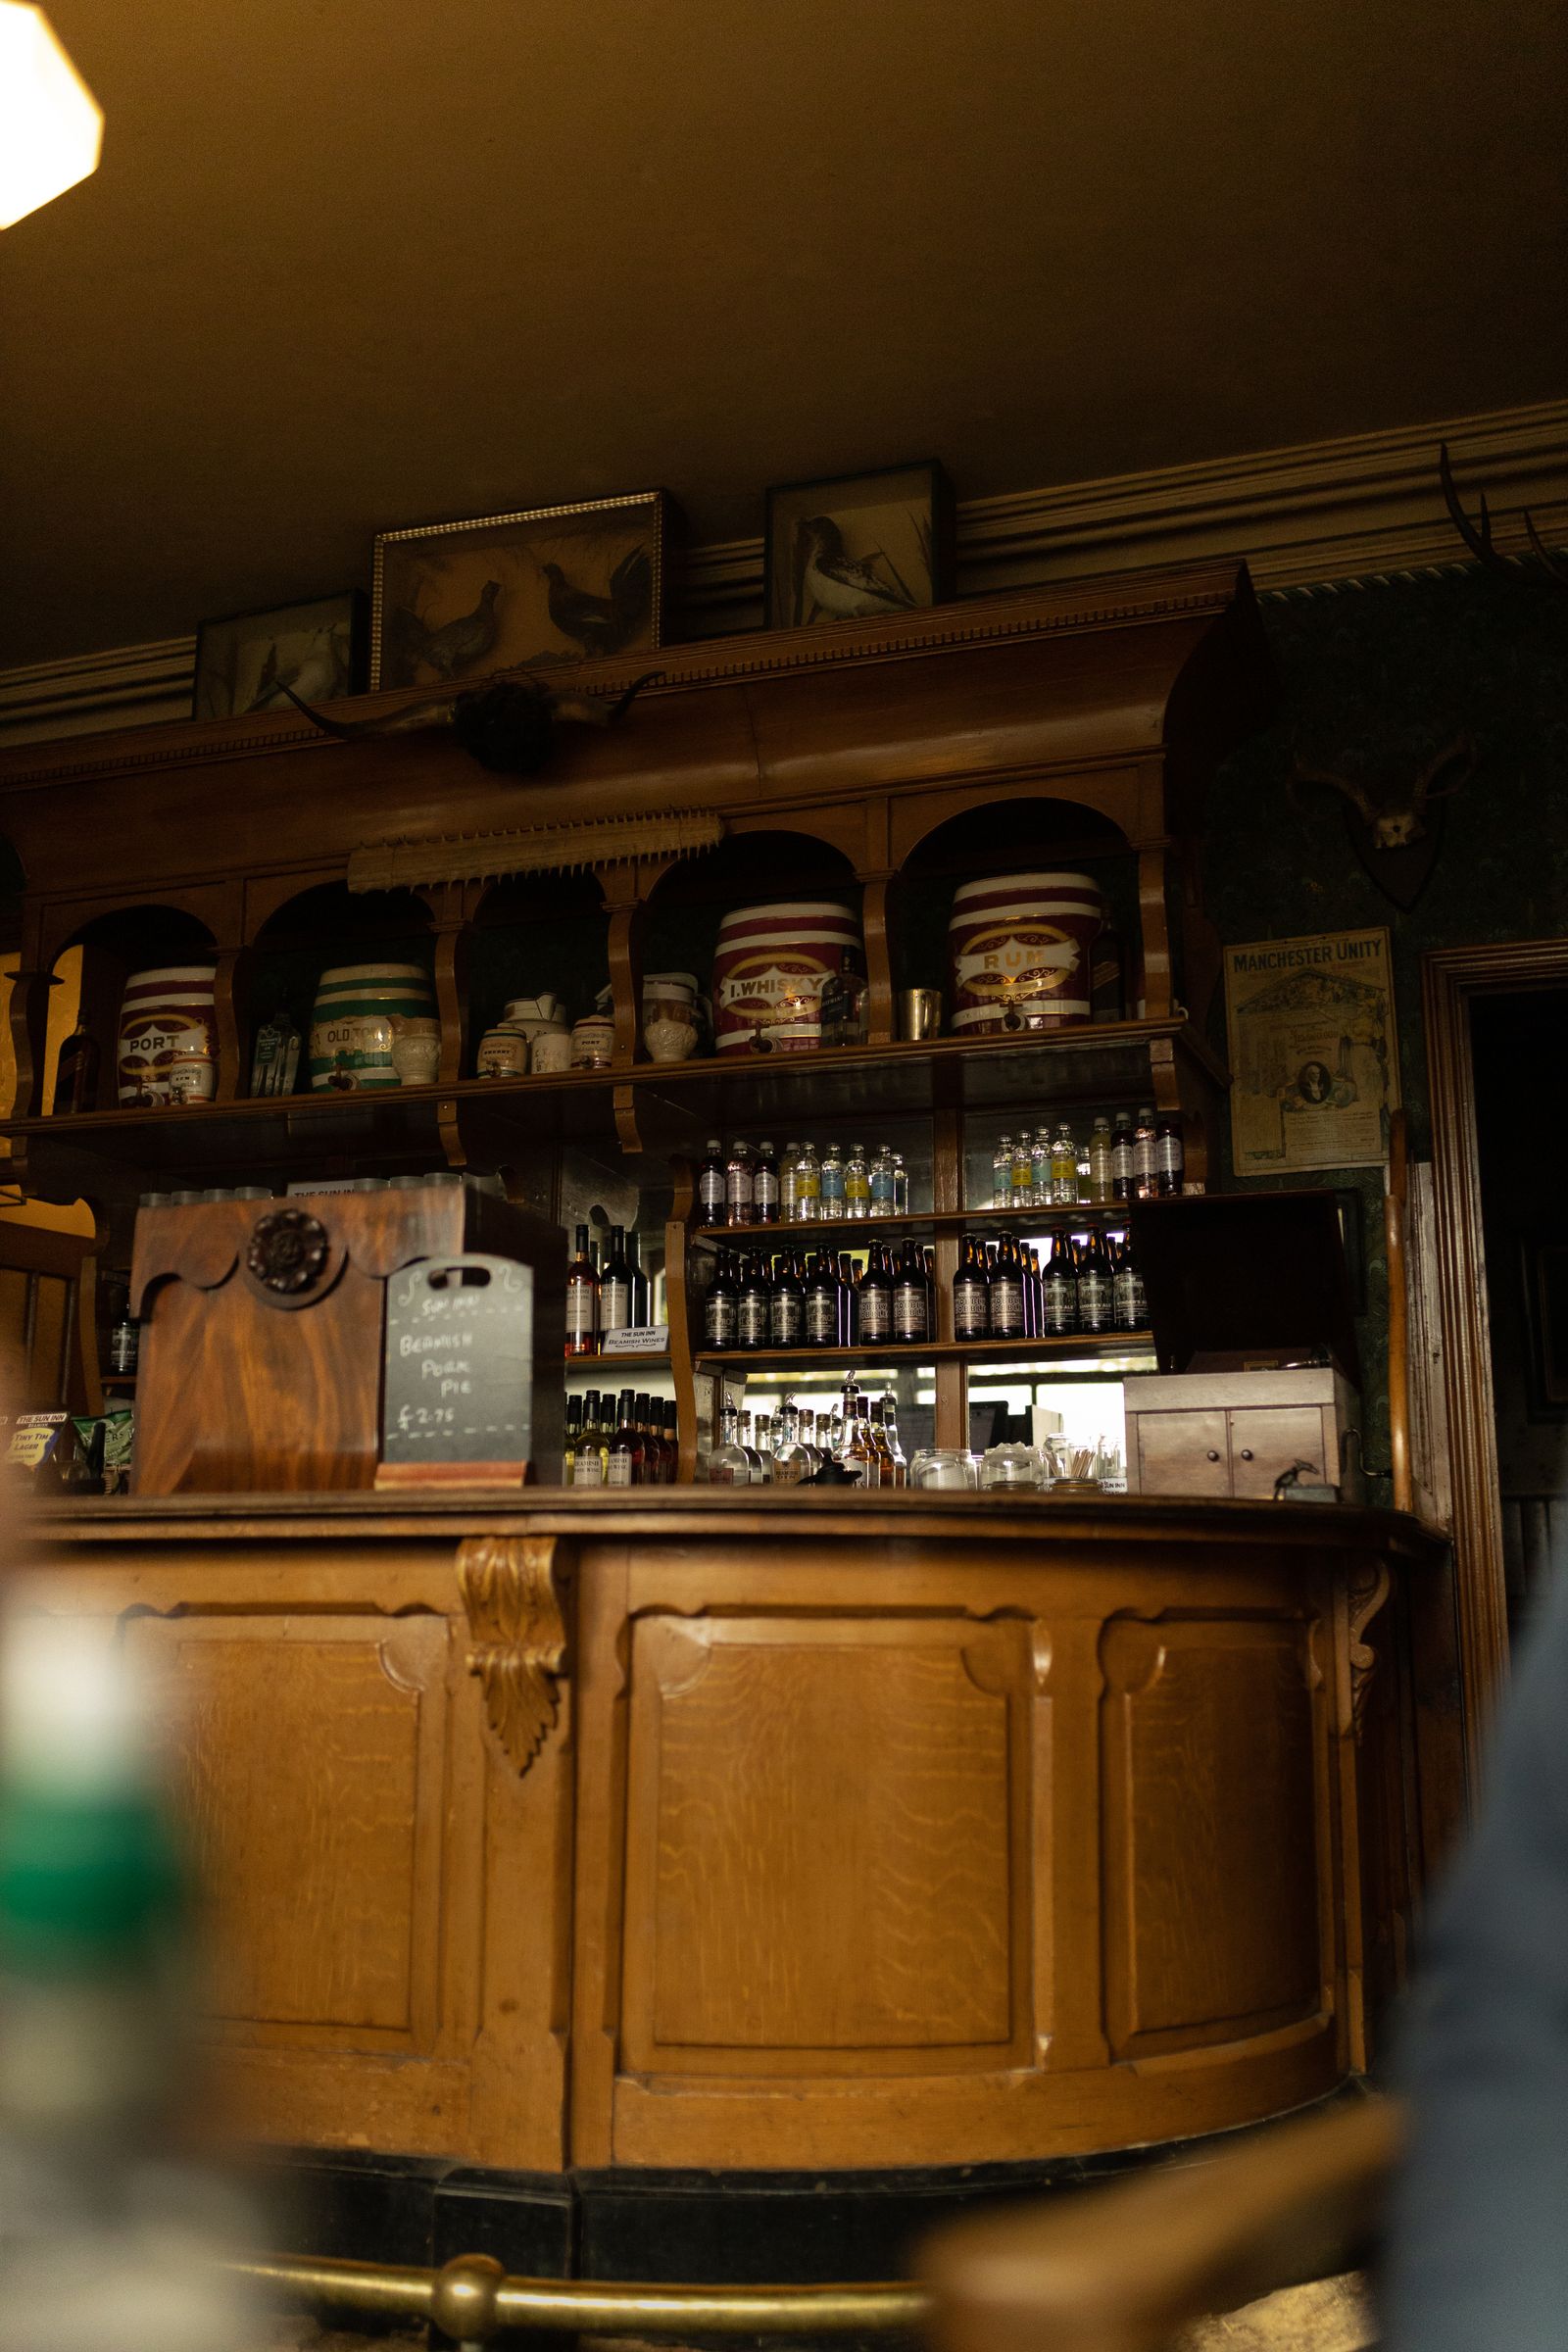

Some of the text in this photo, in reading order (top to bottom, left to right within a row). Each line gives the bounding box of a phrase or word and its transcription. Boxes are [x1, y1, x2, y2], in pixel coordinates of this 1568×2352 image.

[983, 950, 1045, 970] RUM
[1233, 946, 1333, 973] MANCHESTER
[1336, 938, 1382, 961] UNITY
[129, 1035, 179, 1054] PORT
[327, 1030, 350, 1043] OLD
